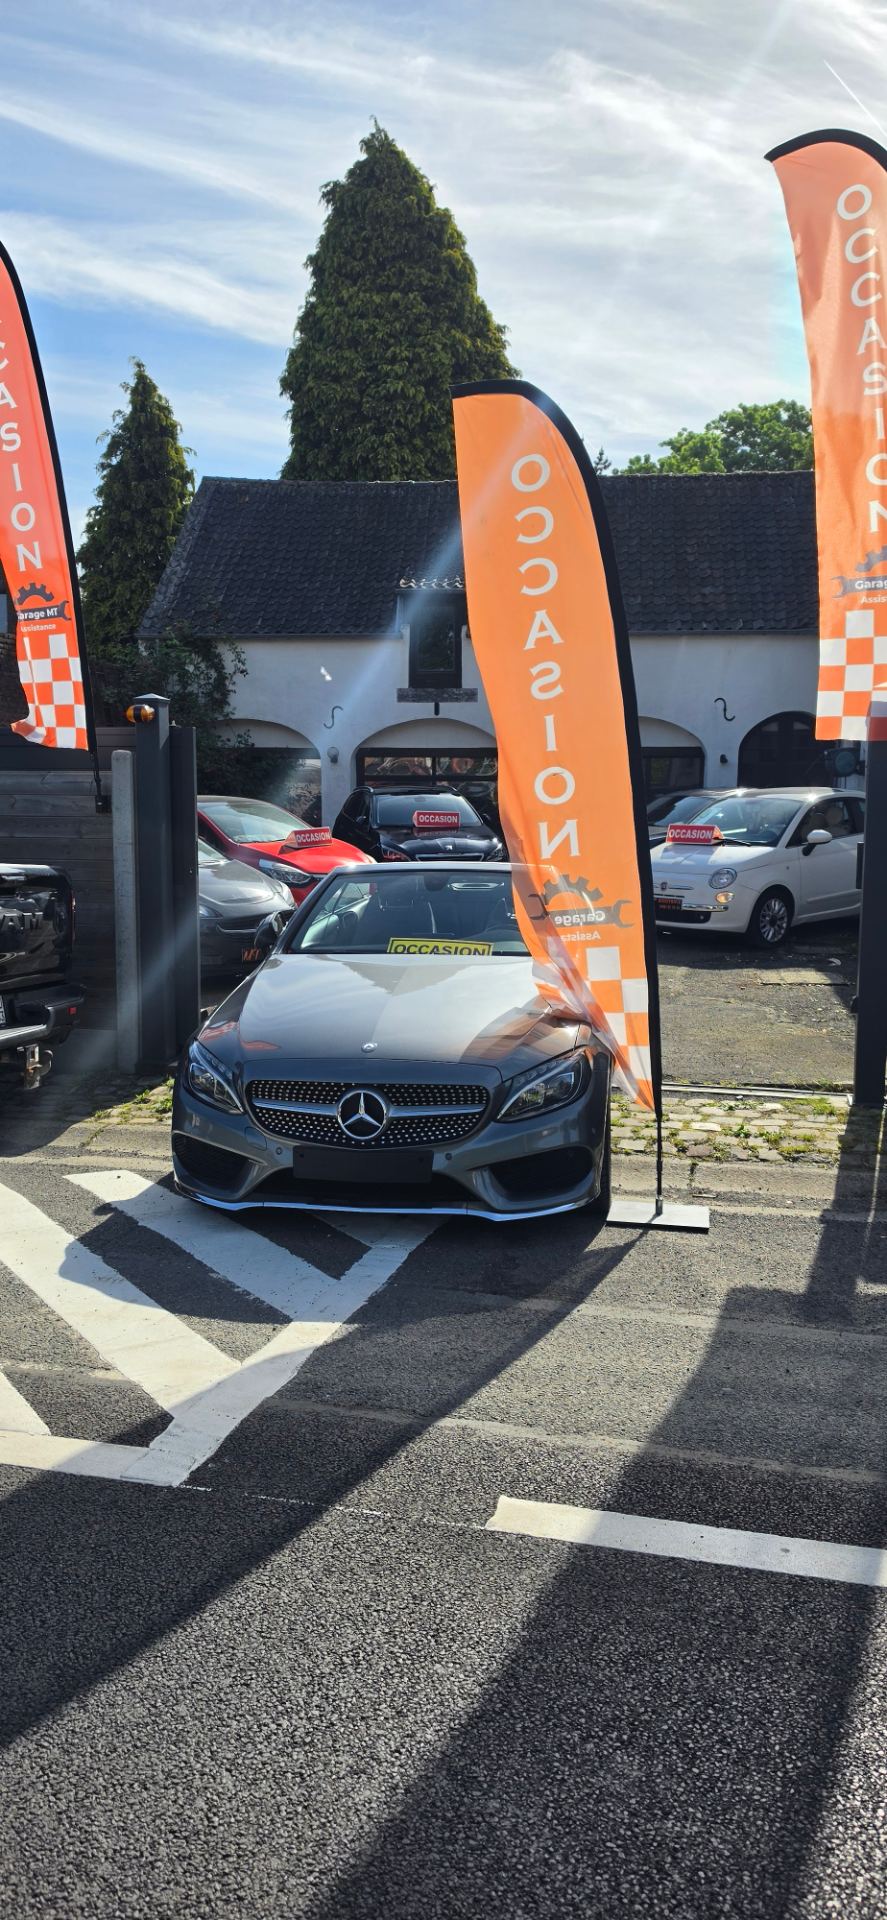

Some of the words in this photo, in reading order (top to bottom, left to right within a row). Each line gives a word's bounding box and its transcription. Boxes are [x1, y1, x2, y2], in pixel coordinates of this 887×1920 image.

[46, 607, 58, 617] MT
[418, 812, 458, 823] OCCASION
[296, 831, 331, 843] OCCASION
[668, 828, 713, 839] OCCASION
[393, 943, 486, 956] OCCASION
